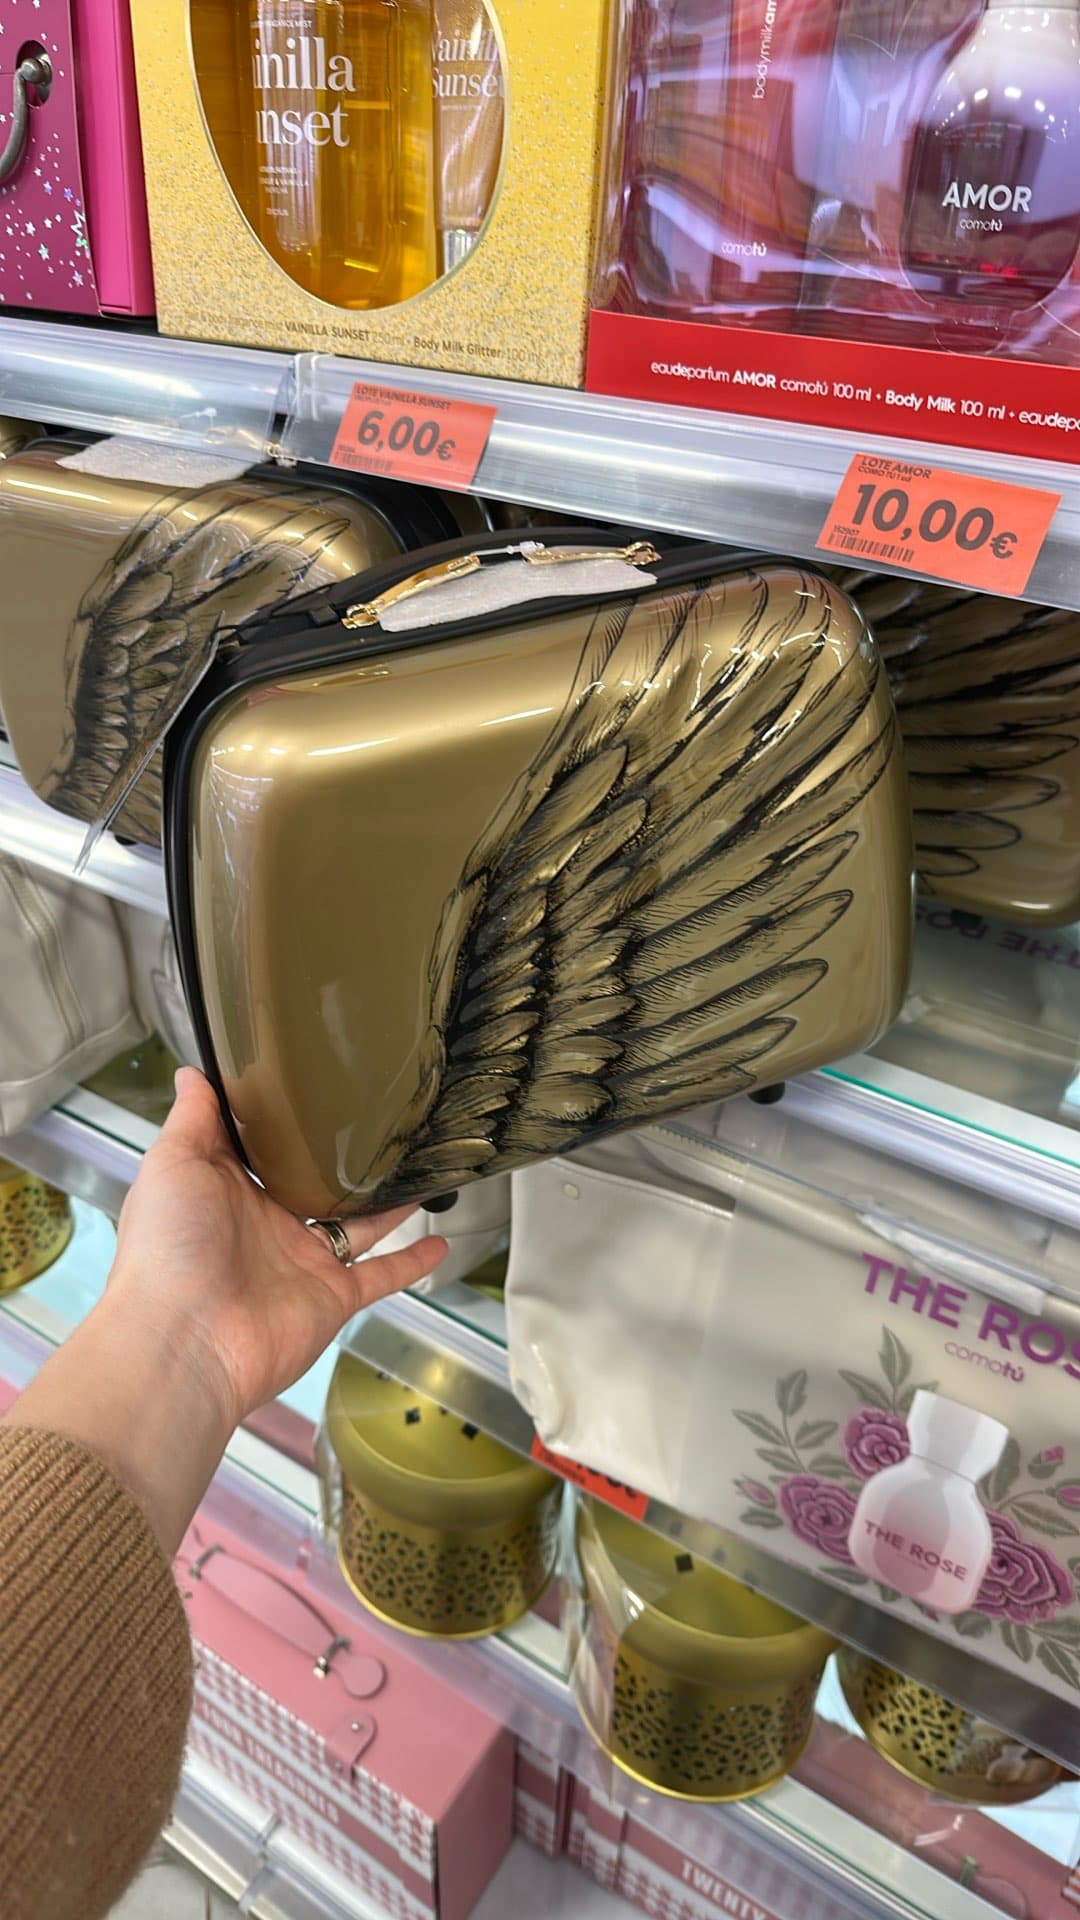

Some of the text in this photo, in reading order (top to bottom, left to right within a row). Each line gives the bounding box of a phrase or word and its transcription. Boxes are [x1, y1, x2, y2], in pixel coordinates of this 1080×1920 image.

[251, 36, 357, 93] inilla
[255, 102, 351, 148] nset
[941, 182, 1032, 213] AMOR
[284, 320, 329, 337] VAINILLA
[330, 326, 369, 342] SUNSET
[413, 335, 440, 354] Body
[441, 340, 465, 353] Milk
[466, 342, 501, 358] Glitter
[651, 361, 730, 384] eaudeparfum
[732, 370, 776, 389] AMOR
[780, 377, 828, 396] comotú
[832, 383, 853, 399] 100
[855, 387, 872, 402] ml
[885, 389, 923, 411] Body
[927, 395, 955, 413] Milk
[960, 399, 983, 417] 100
[987, 405, 1006, 420] ml
[357, 410, 456, 461] 6,00€
[861, 456, 932, 479] LOTE AMOR
[851, 484, 1019, 560] 10,00€
[861, 1251, 968, 1329] THE
[944, 1341, 1025, 1382] comotú
[865, 1519, 905, 1550] THE
[909, 1543, 968, 1581] ROSE
